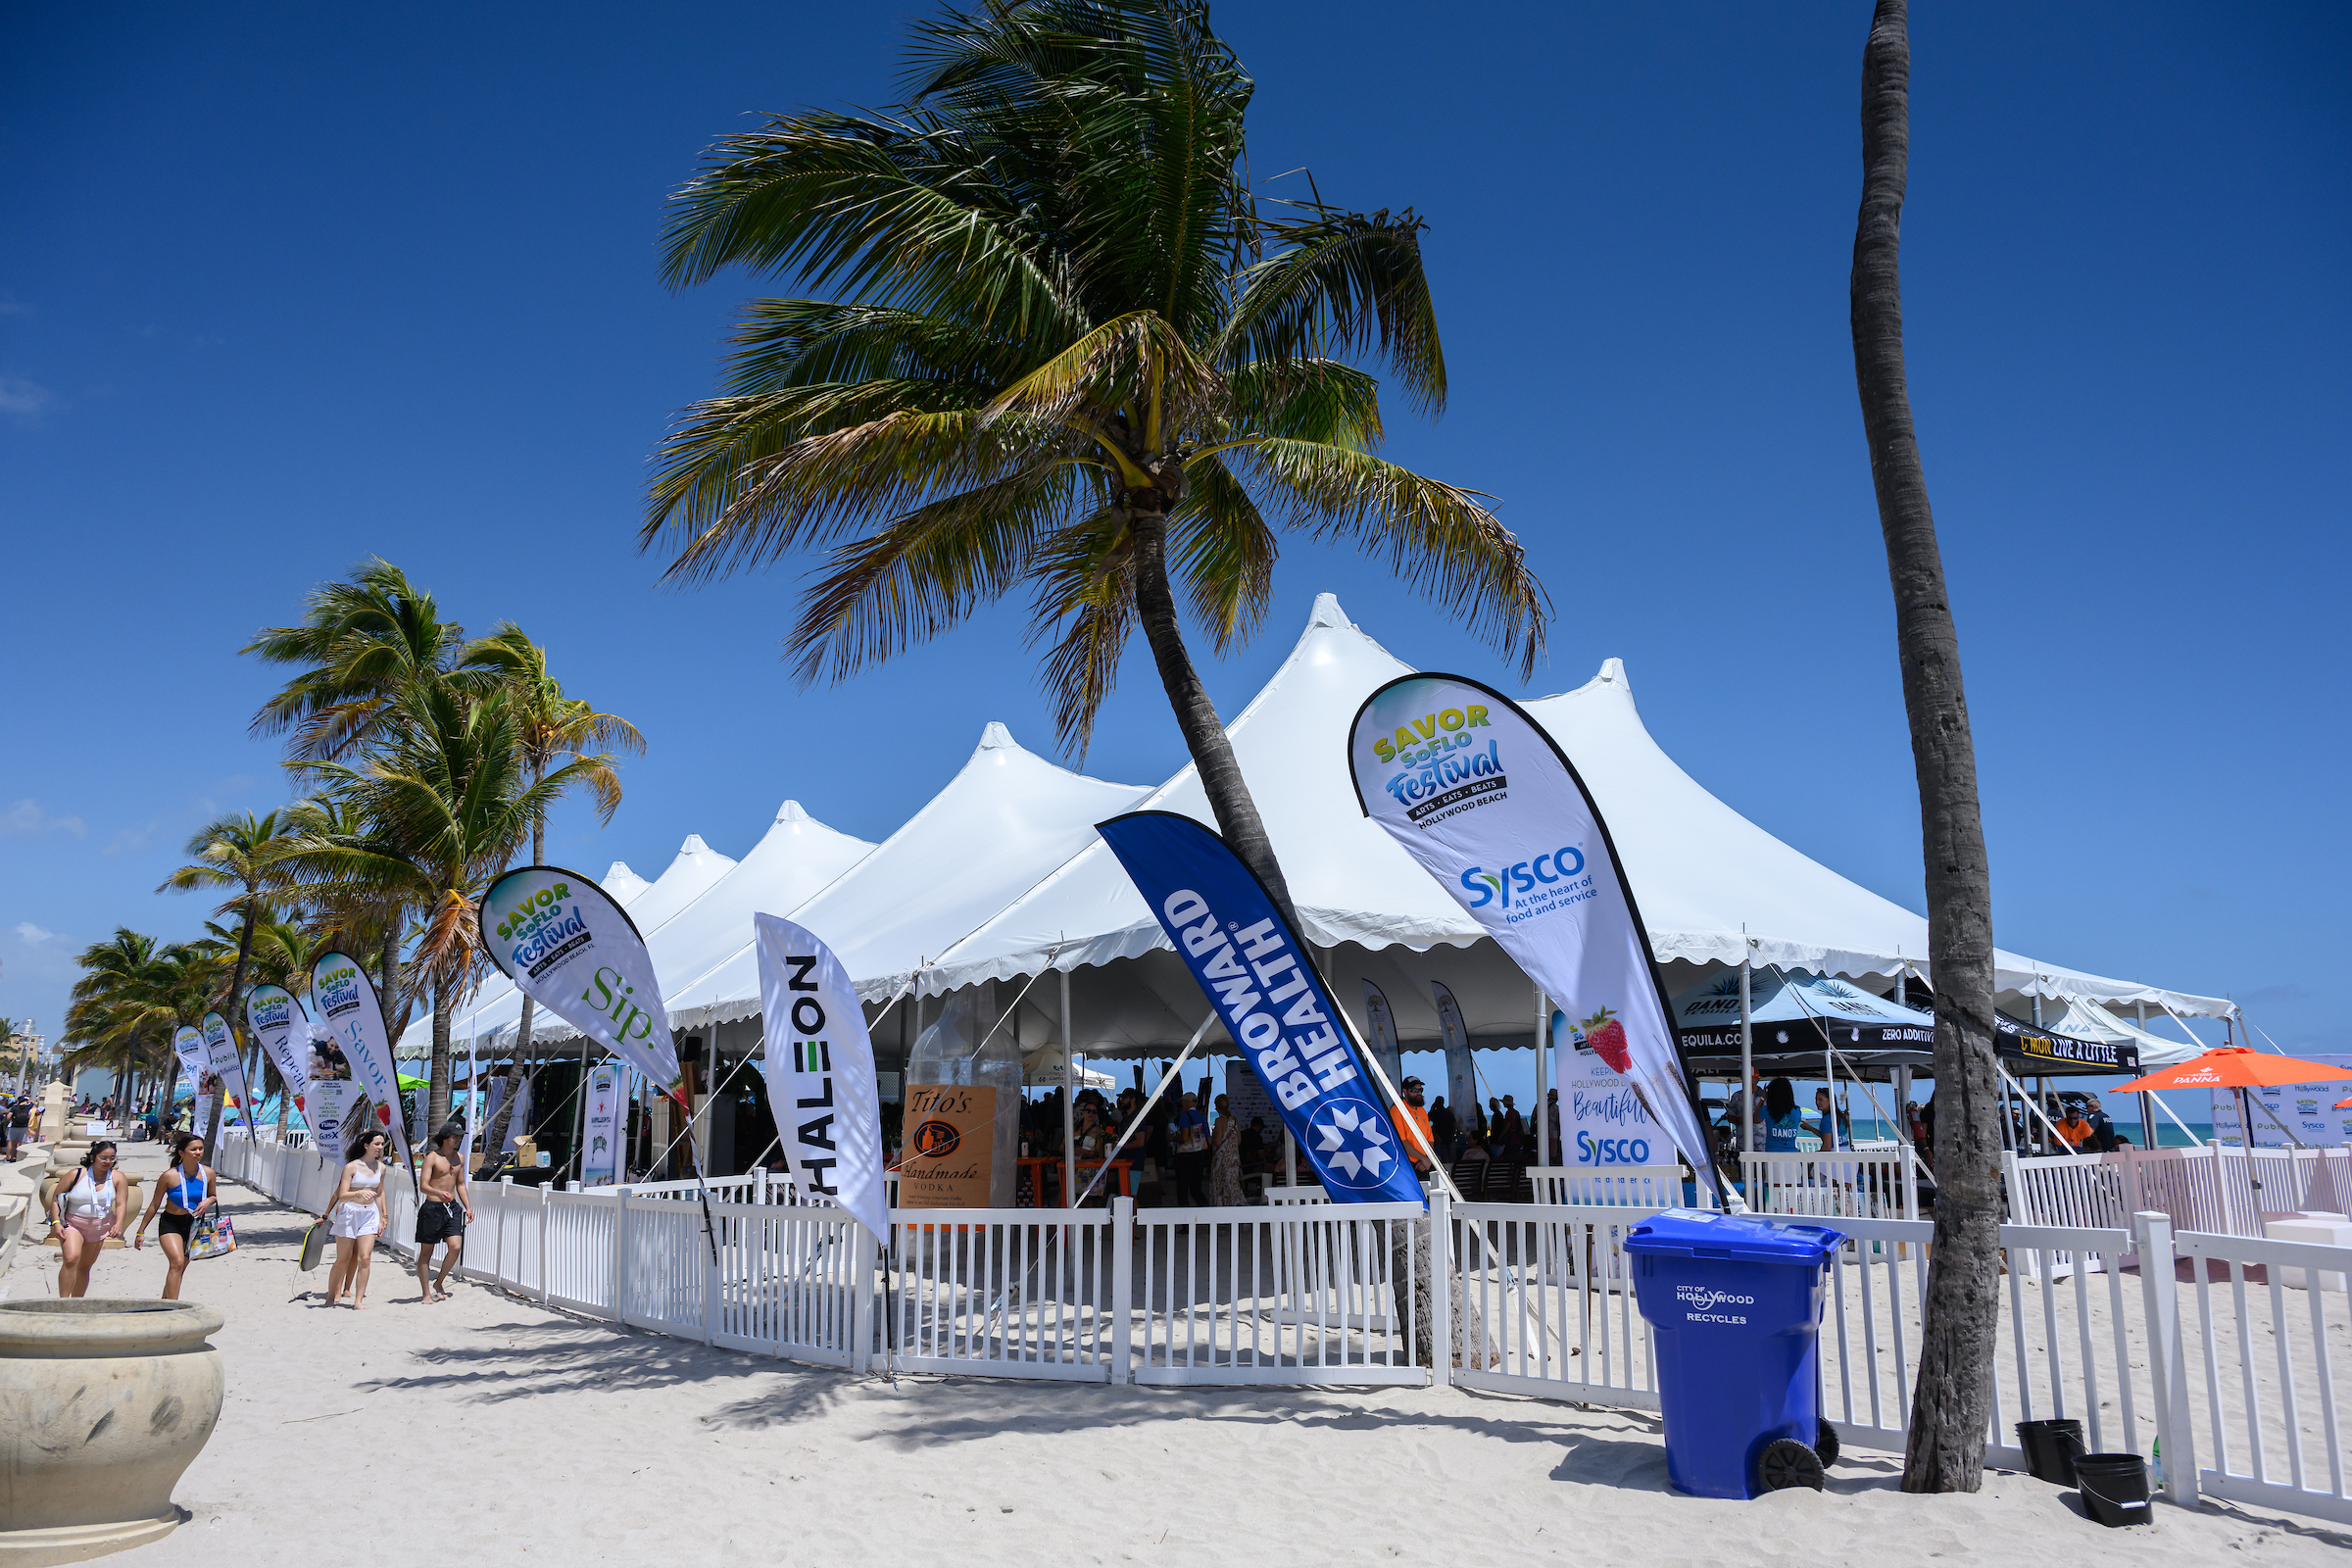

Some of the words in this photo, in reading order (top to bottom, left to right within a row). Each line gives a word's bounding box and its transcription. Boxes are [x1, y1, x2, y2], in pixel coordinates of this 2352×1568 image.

[1373, 704, 1491, 763] SAVOR
[1400, 731, 1472, 769] SoFLO
[1386, 739, 1504, 807] Festival
[1414, 801, 1436, 817] ARTS
[1443, 790, 1463, 804] EATS
[1471, 780, 1497, 794] BEATS
[1418, 801, 1475, 830] HOLLYWOOD
[1476, 791, 1508, 808] BEACH
[1505, 907, 1534, 925] food
[1536, 901, 1557, 915] and
[1558, 888, 1598, 907] service
[1514, 899, 1528, 909] At
[1529, 891, 1548, 906] the
[1548, 880, 1580, 899] heart
[1581, 874, 1593, 887] of
[496, 882, 572, 942] SAVOR
[512, 906, 588, 968] Festival
[532, 960, 549, 975] ARTS
[550, 947, 565, 960] EATS
[568, 936, 586, 950] BEATS
[318, 967, 356, 990] SAVOR
[534, 957, 570, 985] HOLLYWOOD
[252, 996, 289, 1010] SAVOR
[320, 984, 360, 1010] Festival
[581, 966, 655, 1050] Sip.
[1163, 889, 1320, 1111] BROWARD
[1233, 917, 1358, 1093] HEALTH
[254, 1007, 290, 1026] Festival
[1882, 1029, 1902, 1041] ZERO
[274, 1035, 306, 1092] Repeat.
[344, 1019, 387, 1094] Savor.
[2020, 1035, 2052, 1055] C'MON
[2052, 1038, 2075, 1058] LIVE
[2076, 1041, 2084, 1060] A
[2084, 1043, 2118, 1063] LITTLE
[785, 955, 838, 1197] HALEON
[1571, 1079, 1619, 1089] HOLLYWOOD
[911, 1088, 971, 1113] Tito's
[1577, 1130, 1650, 1167] Sysco
[1772, 1128, 1797, 1138] DANO'S
[904, 1161, 978, 1180] Handmade
[913, 1182, 954, 1192] VODKA
[1676, 1290, 1755, 1310] HOLLYWOOD
[1687, 1312, 1747, 1325] RECYCLES
